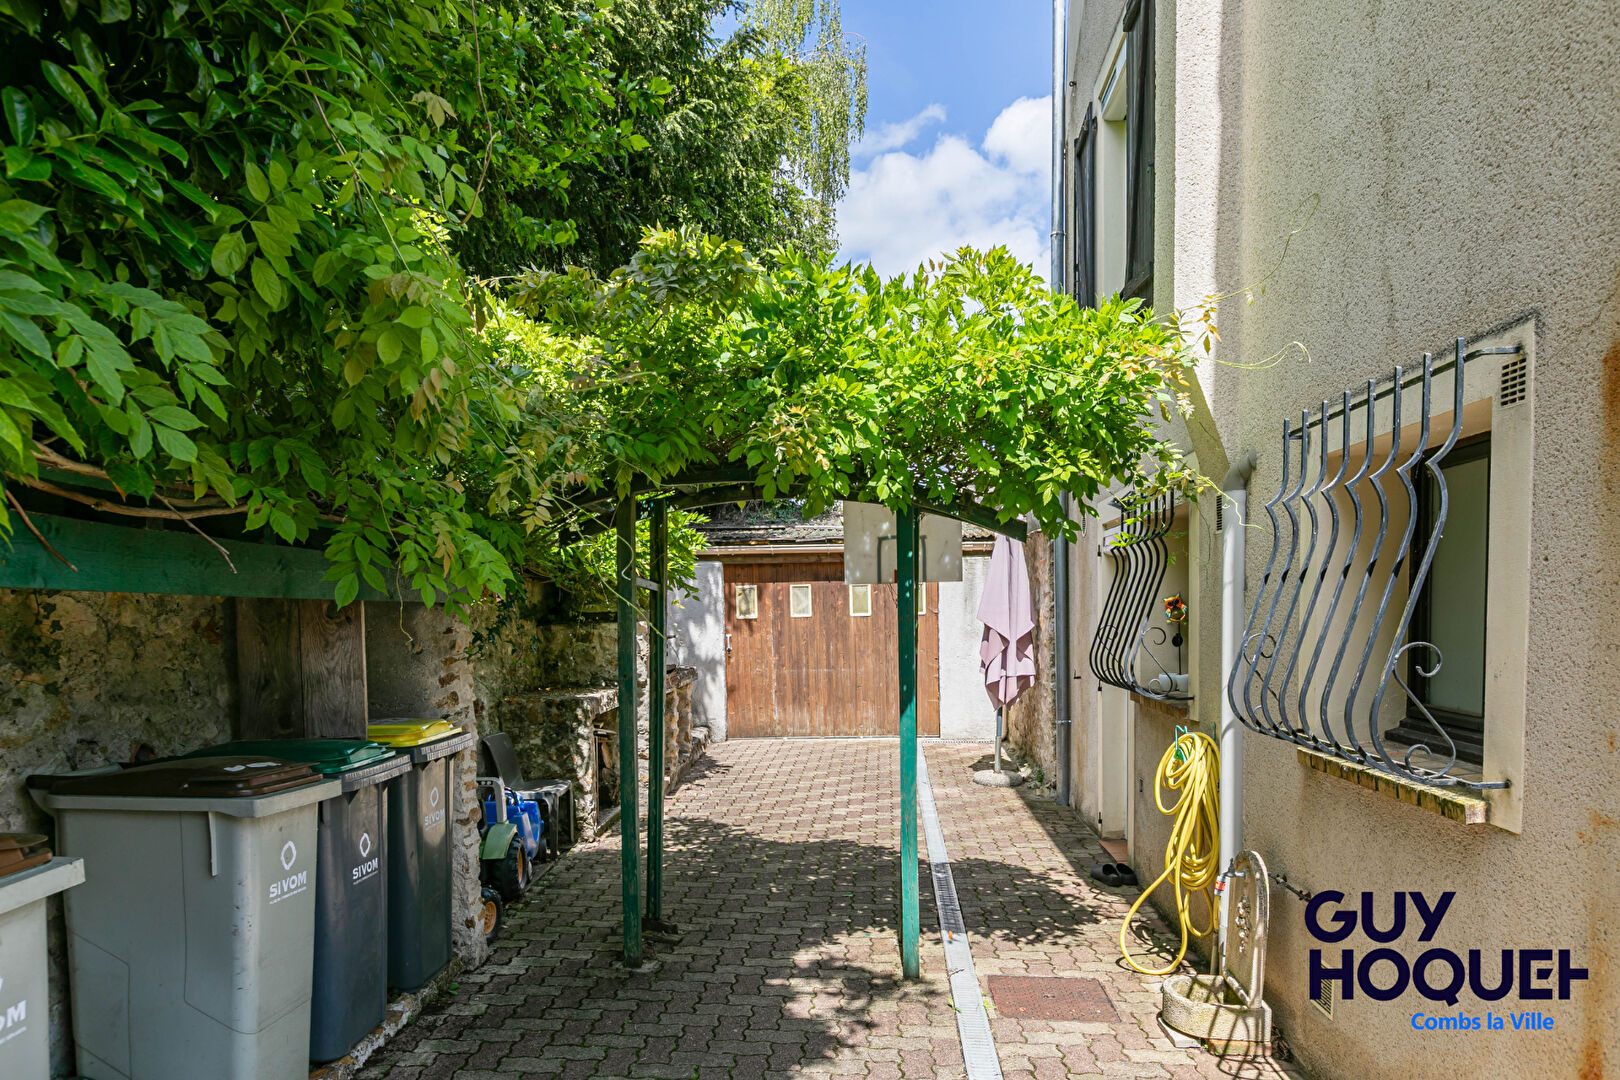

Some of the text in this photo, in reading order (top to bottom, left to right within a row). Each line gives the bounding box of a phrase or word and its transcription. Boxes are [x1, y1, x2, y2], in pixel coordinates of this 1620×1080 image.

[424, 808, 445, 826] SIVOM
[352, 857, 378, 879] SIVOM
[269, 871, 307, 898] SIVOM
